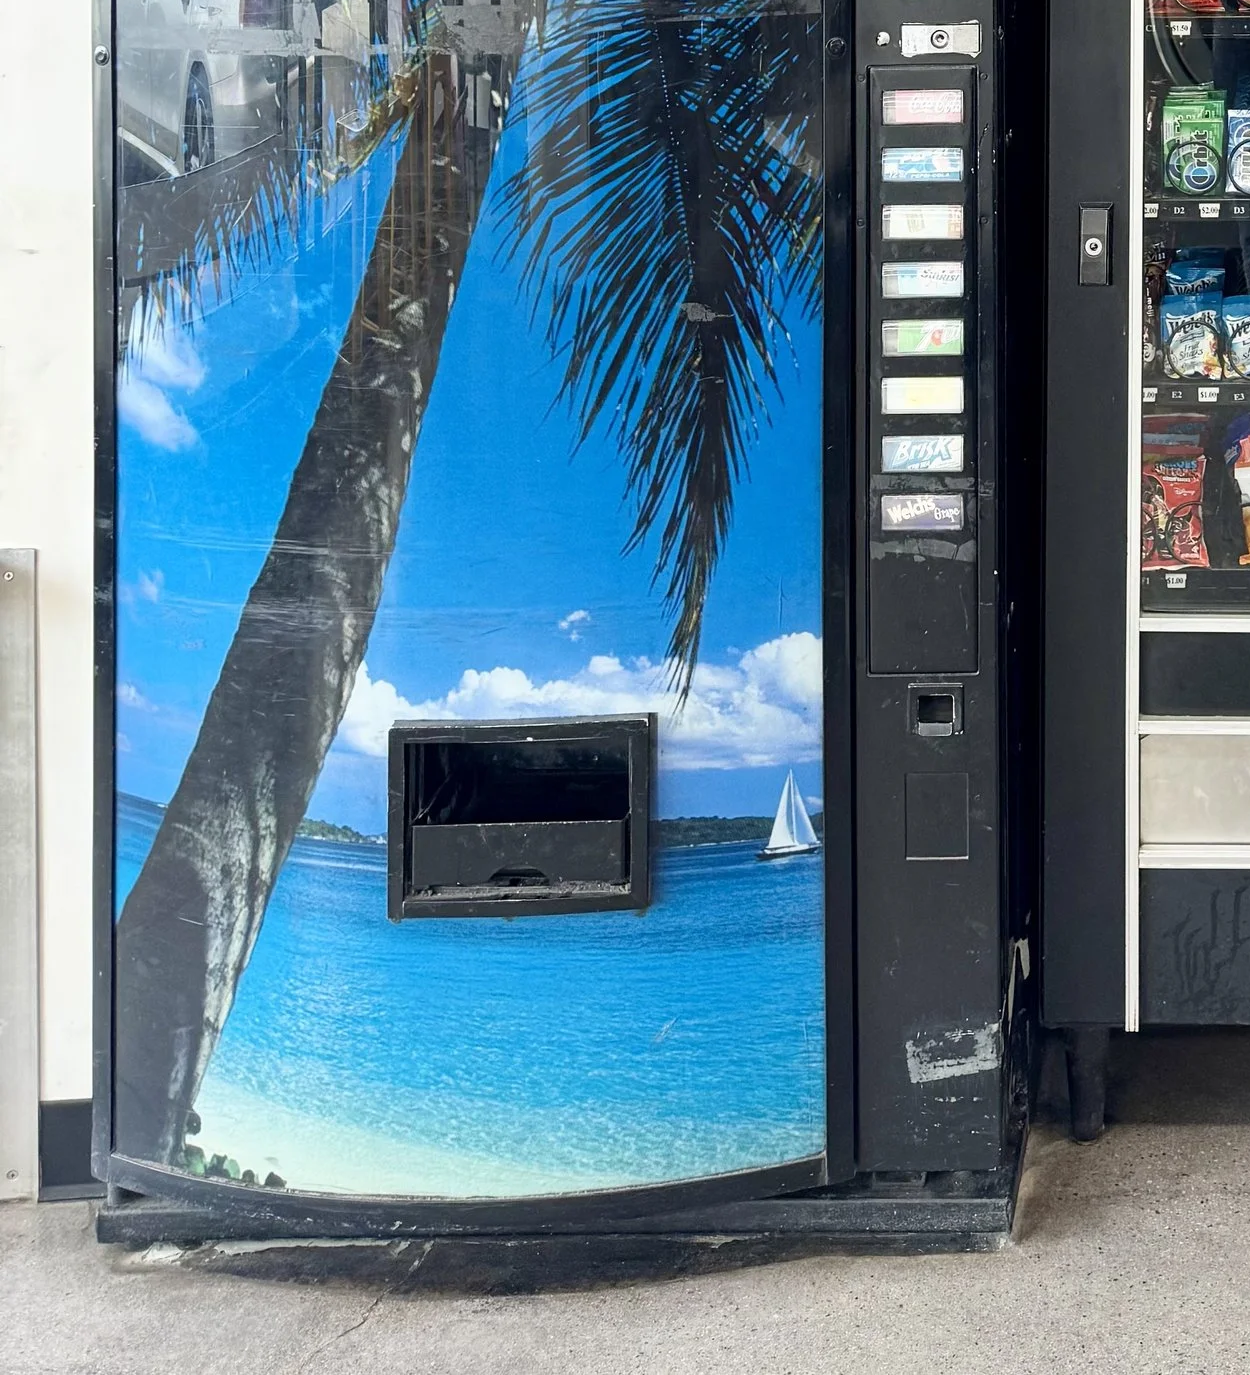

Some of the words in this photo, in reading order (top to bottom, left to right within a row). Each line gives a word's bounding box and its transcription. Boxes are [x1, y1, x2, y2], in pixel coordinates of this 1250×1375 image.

[1174, 206, 1185, 214] D2
[1201, 206, 1219, 214] $2.00
[1234, 206, 1245, 214] D3
[887, 496, 936, 524] Welch's
[933, 506, 961, 523] Grape
